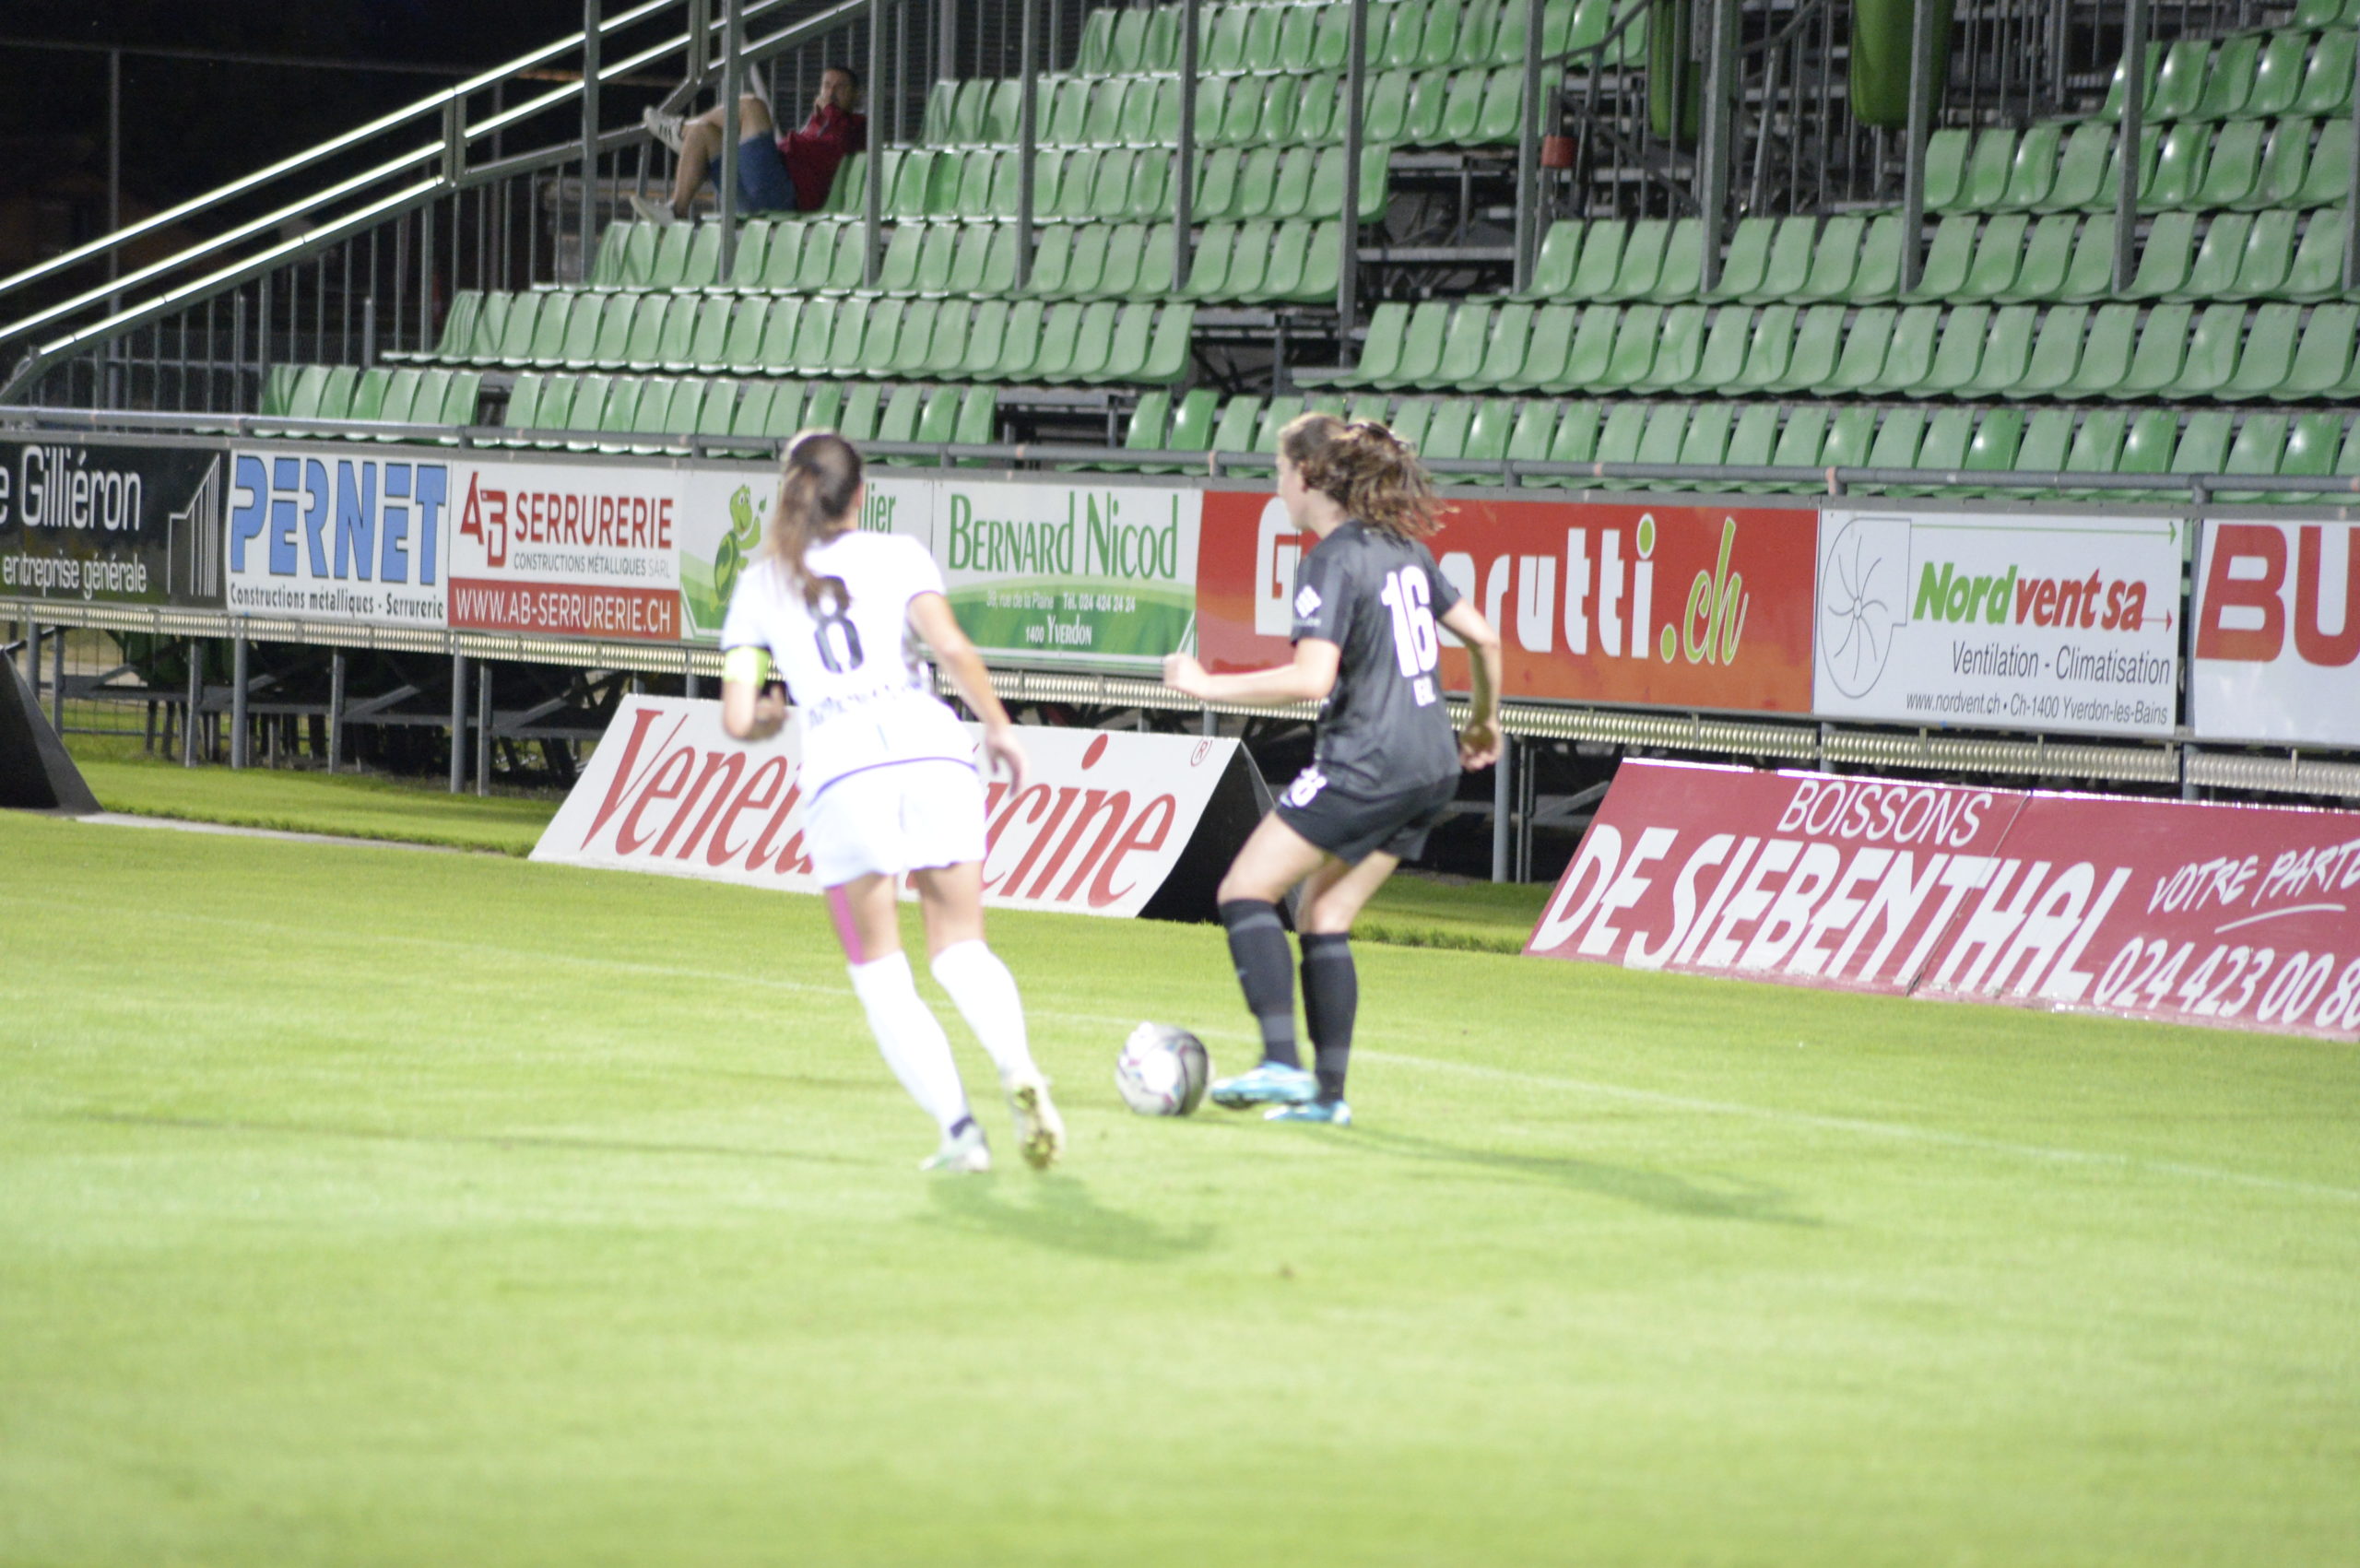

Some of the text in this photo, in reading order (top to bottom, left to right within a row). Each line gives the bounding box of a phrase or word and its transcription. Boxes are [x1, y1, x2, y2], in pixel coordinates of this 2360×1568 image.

[21, 444, 141, 532] Gilliéron
[230, 454, 448, 585] PERNET
[515, 491, 674, 549] SERRURERIE
[3, 548, 147, 599] entreprise générale
[513, 551, 671, 579] CONSTRUCTIONS MÉTALLIQUES SARL
[230, 582, 443, 620] Constructions métalliques Serrurerie
[455, 587, 671, 633] WWW.AB-SERRURERIE.CH
[1079, 593, 1094, 612] 024
[1096, 593, 1111, 613] 424
[1113, 595, 1123, 613] 24
[1125, 595, 1137, 614] 24
[1380, 565, 1438, 678] 16
[1025, 624, 1044, 643] 1400
[1953, 641, 2170, 685] Ventilation Climatisation
[1906, 690, 2167, 725] www.nordvent.ch Ch-1400 Yverdon-les-Bains
[1777, 778, 1991, 847] BOISSONS
[2147, 855, 2259, 914] VOTRE
[1530, 823, 2133, 1003] DE SIEBENTHAL
